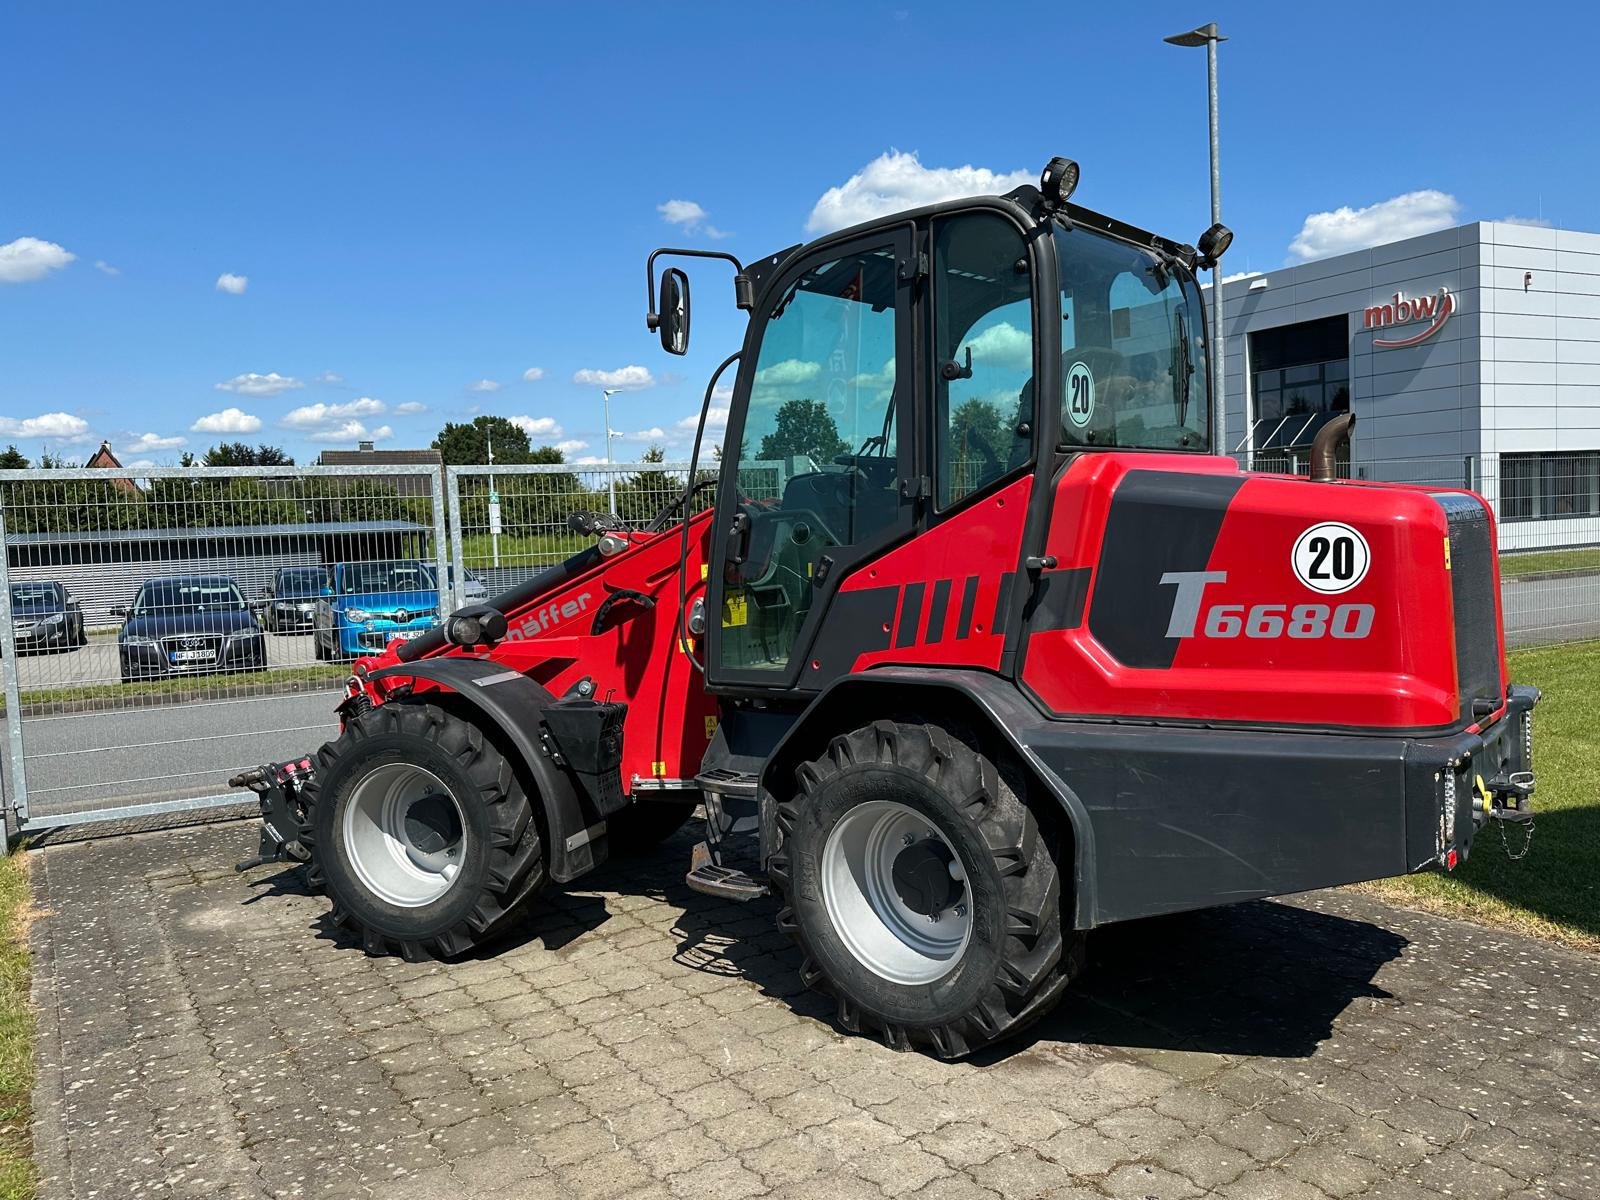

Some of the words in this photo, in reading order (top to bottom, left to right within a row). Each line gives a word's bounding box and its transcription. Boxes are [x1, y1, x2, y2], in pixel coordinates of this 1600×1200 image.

[1364, 291, 1437, 328] mbw
[1071, 374, 1089, 414] 20
[1308, 536, 1355, 580] 20
[1159, 570, 1376, 639] T6680
